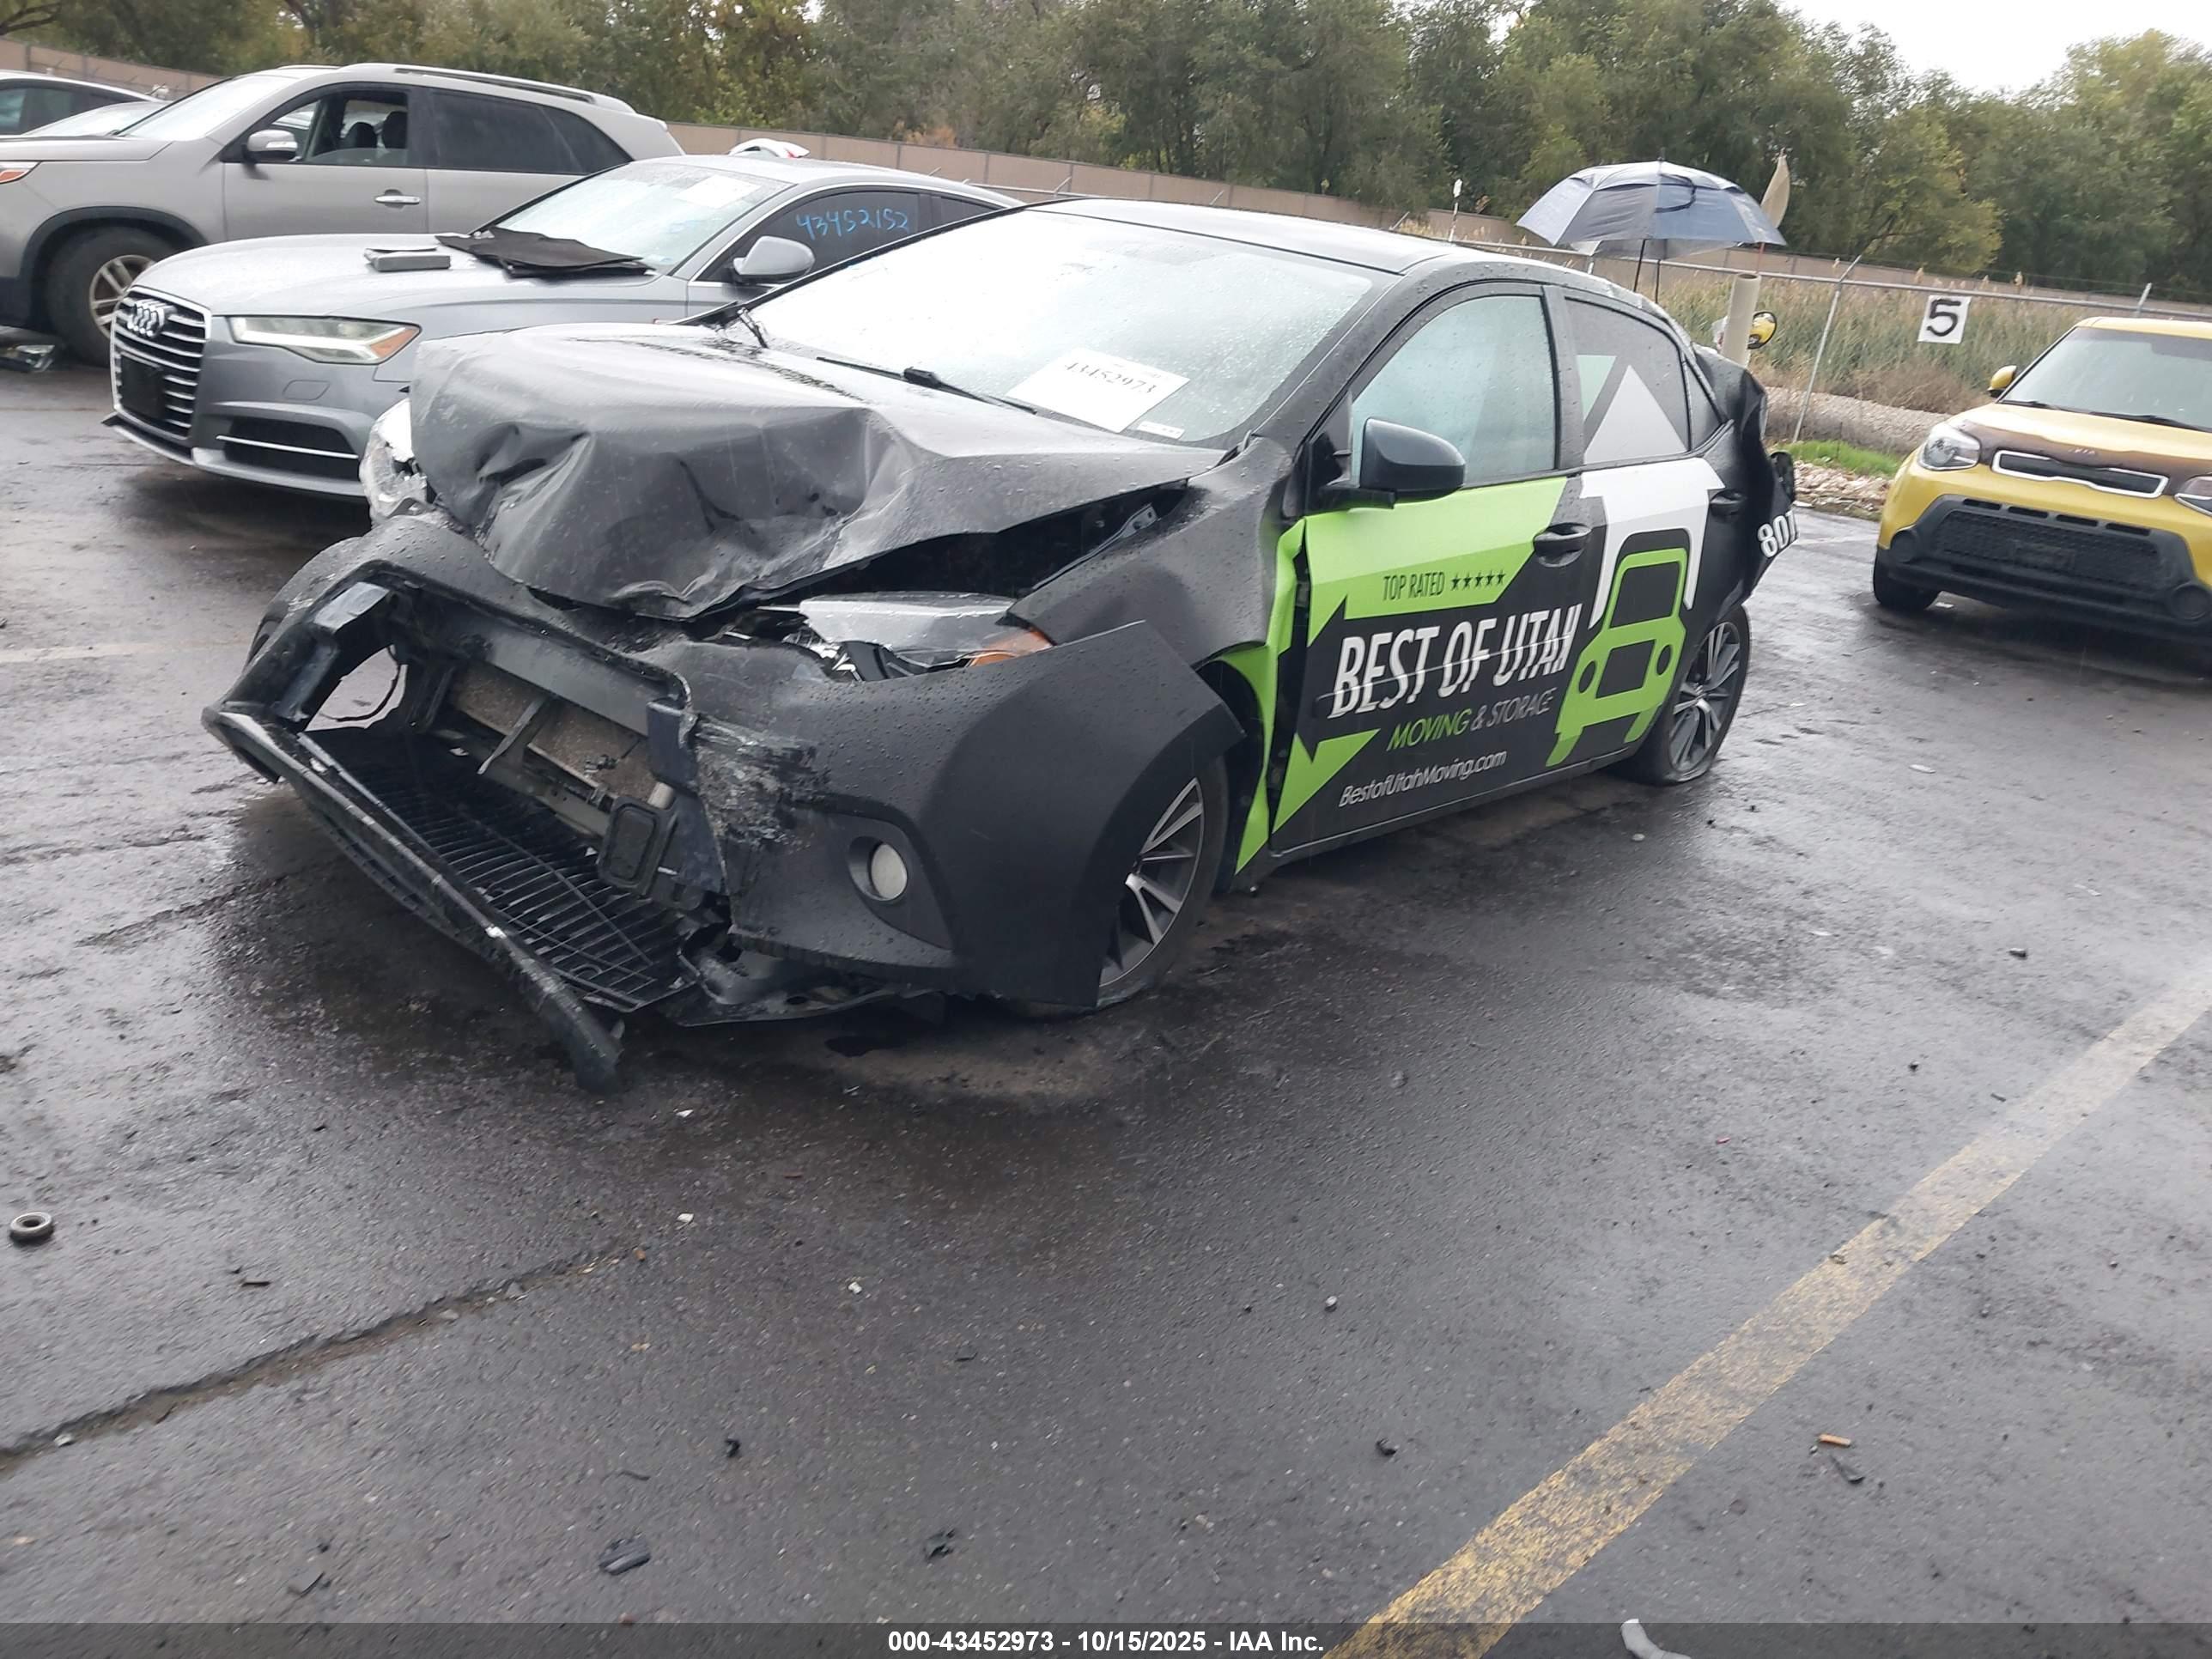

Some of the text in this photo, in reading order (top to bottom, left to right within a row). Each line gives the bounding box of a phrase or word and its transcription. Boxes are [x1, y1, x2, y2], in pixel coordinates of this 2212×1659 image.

[795, 208, 909, 240] 43452152
[1926, 298, 1962, 337] 5
[1383, 571, 1446, 601] TOP RATED
[1327, 603, 1583, 720] BEST OF UTAH
[1386, 687, 1557, 752] MOVING & STORAGE
[1338, 750, 1508, 808] BestofUtahMoving.com
